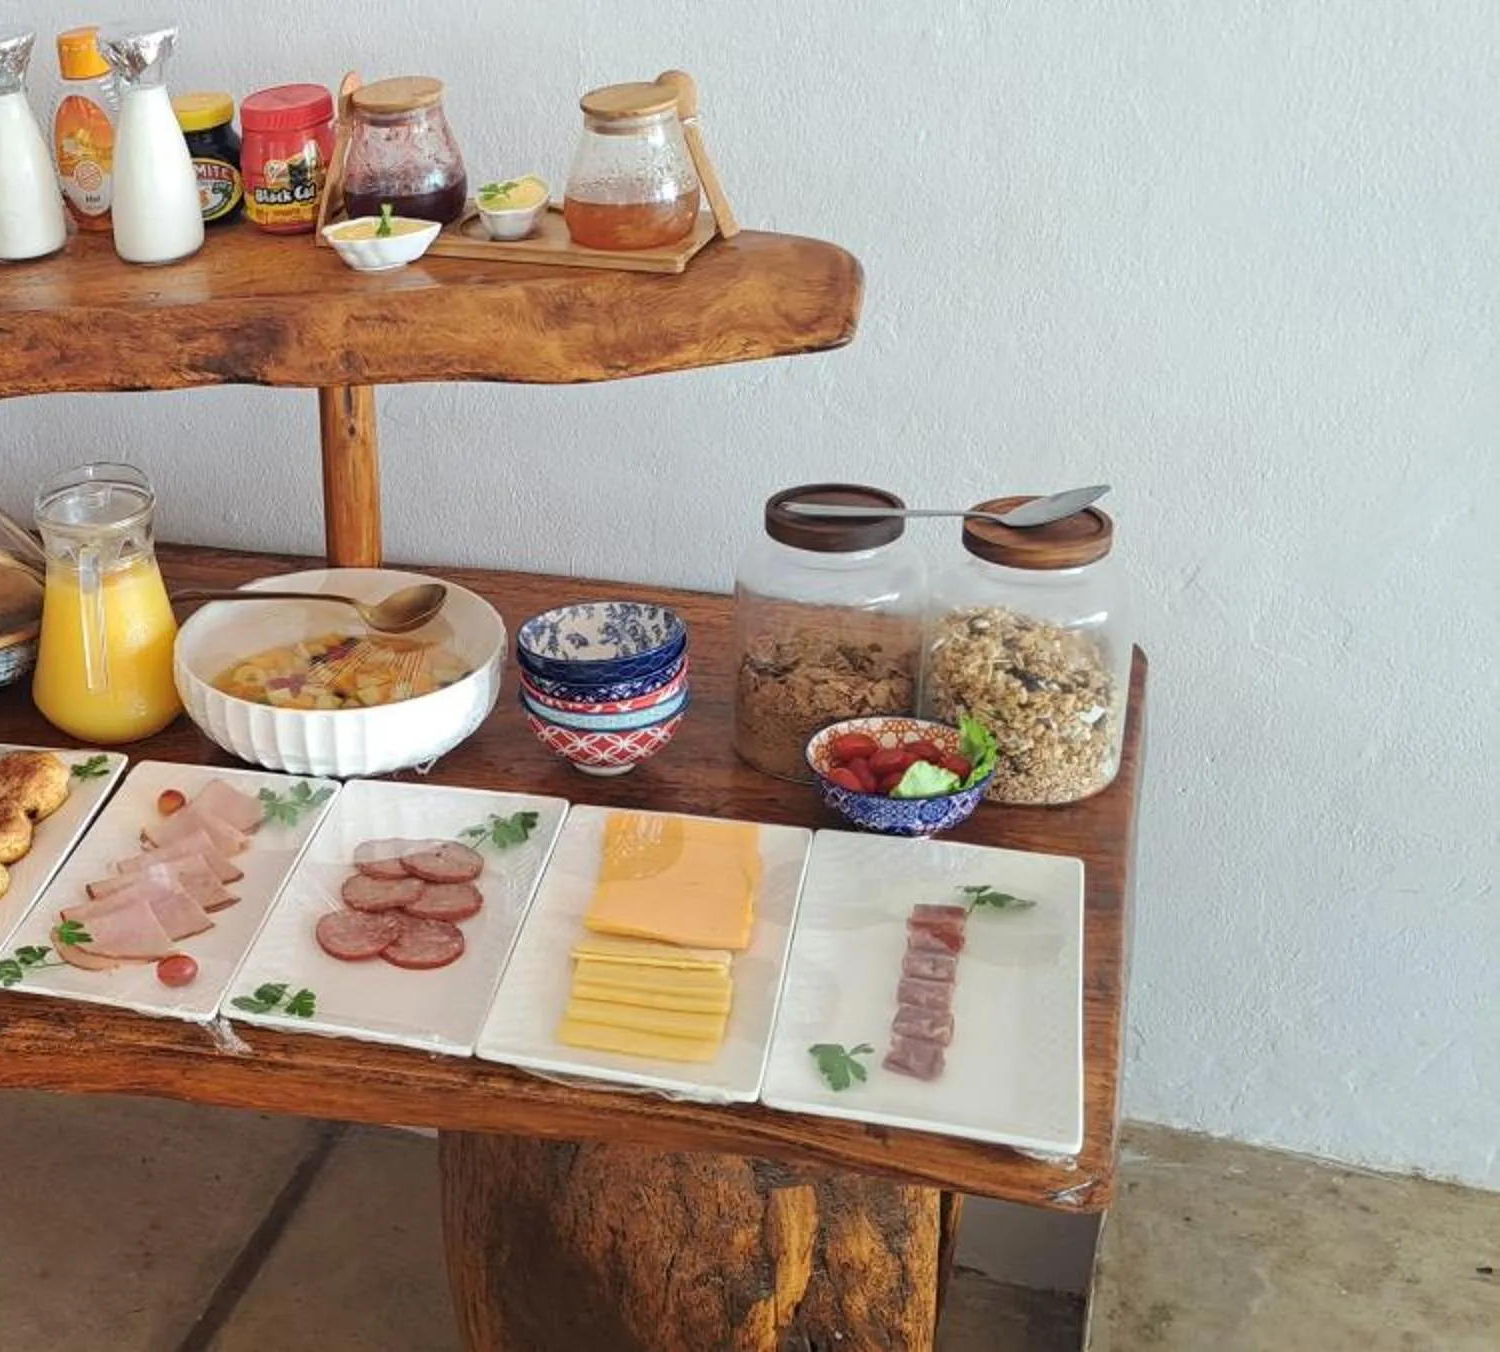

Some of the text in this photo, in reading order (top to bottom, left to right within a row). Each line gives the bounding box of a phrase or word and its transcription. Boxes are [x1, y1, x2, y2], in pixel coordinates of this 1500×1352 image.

[195, 164, 231, 179] MITE
[255, 183, 316, 203] Black Cat
